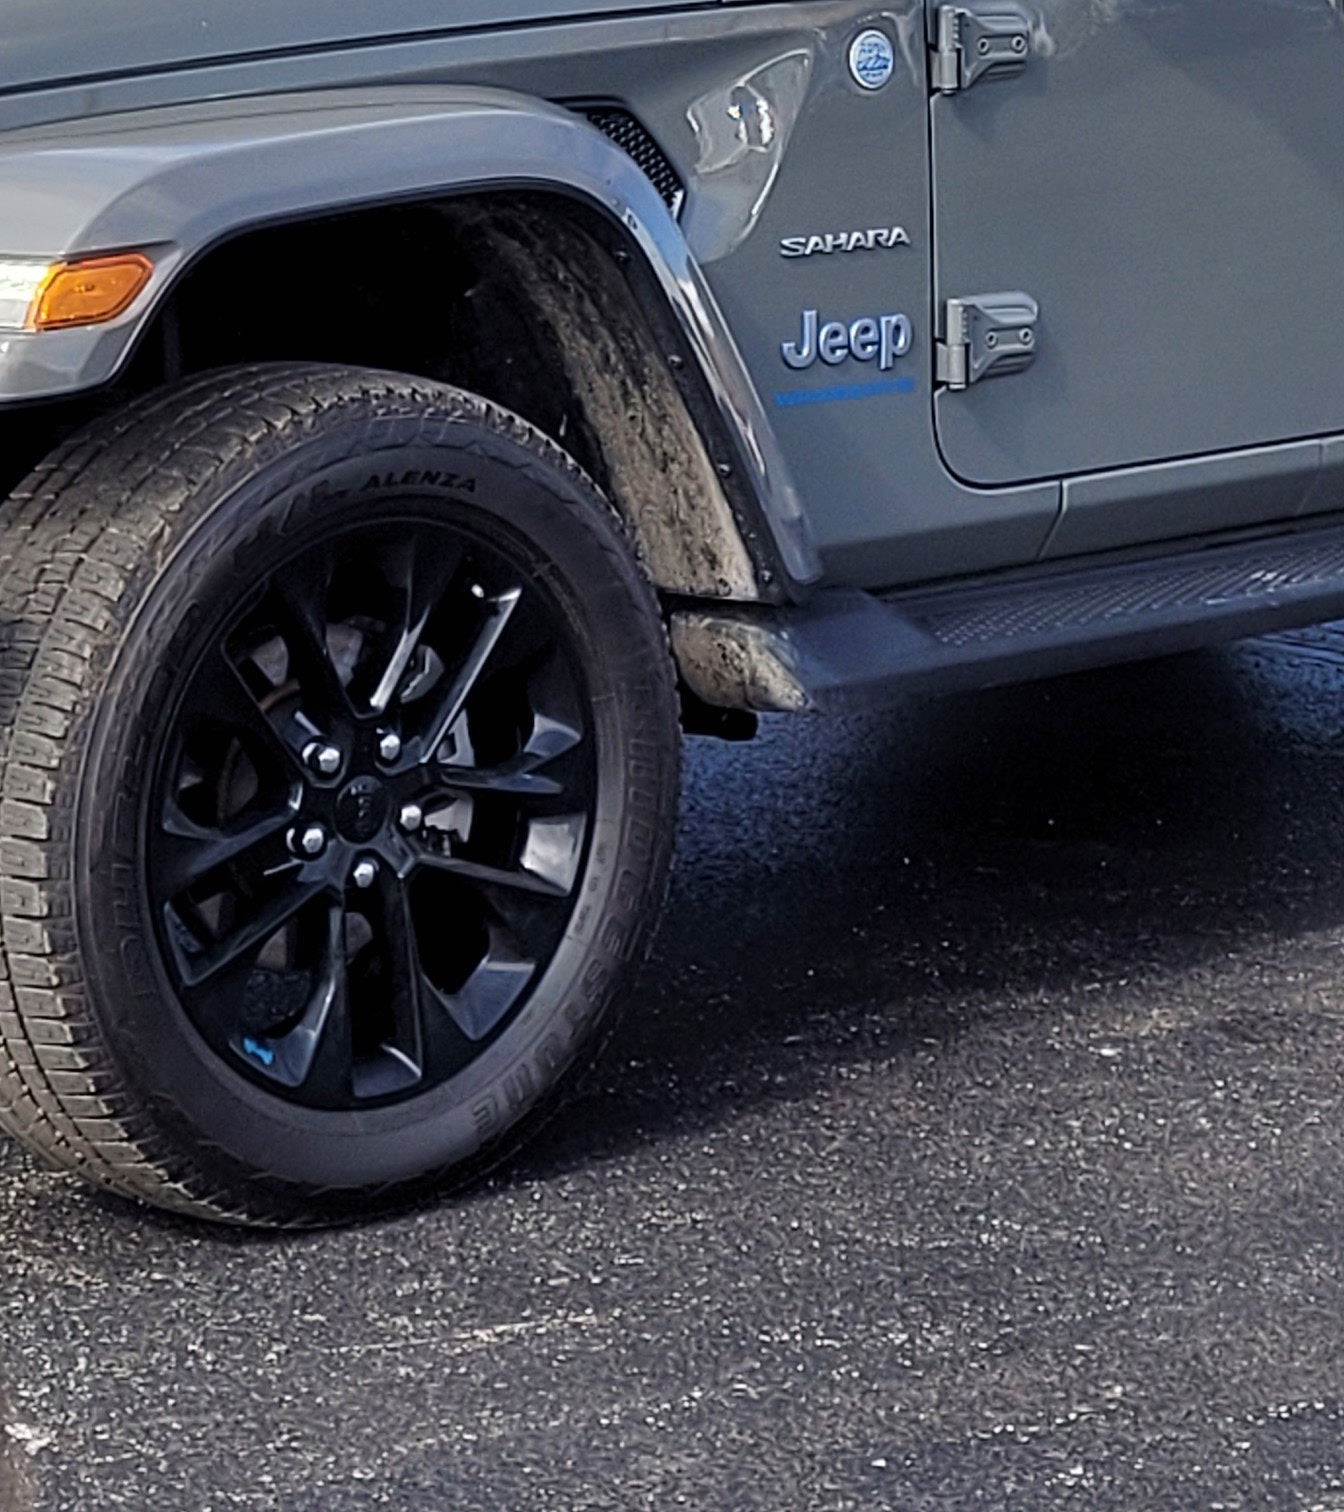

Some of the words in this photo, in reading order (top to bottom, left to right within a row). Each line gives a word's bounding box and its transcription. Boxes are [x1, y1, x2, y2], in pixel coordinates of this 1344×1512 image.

[780, 226, 911, 258] SAHARA
[781, 309, 913, 370] Jeep
[362, 470, 476, 493] ALENZA
